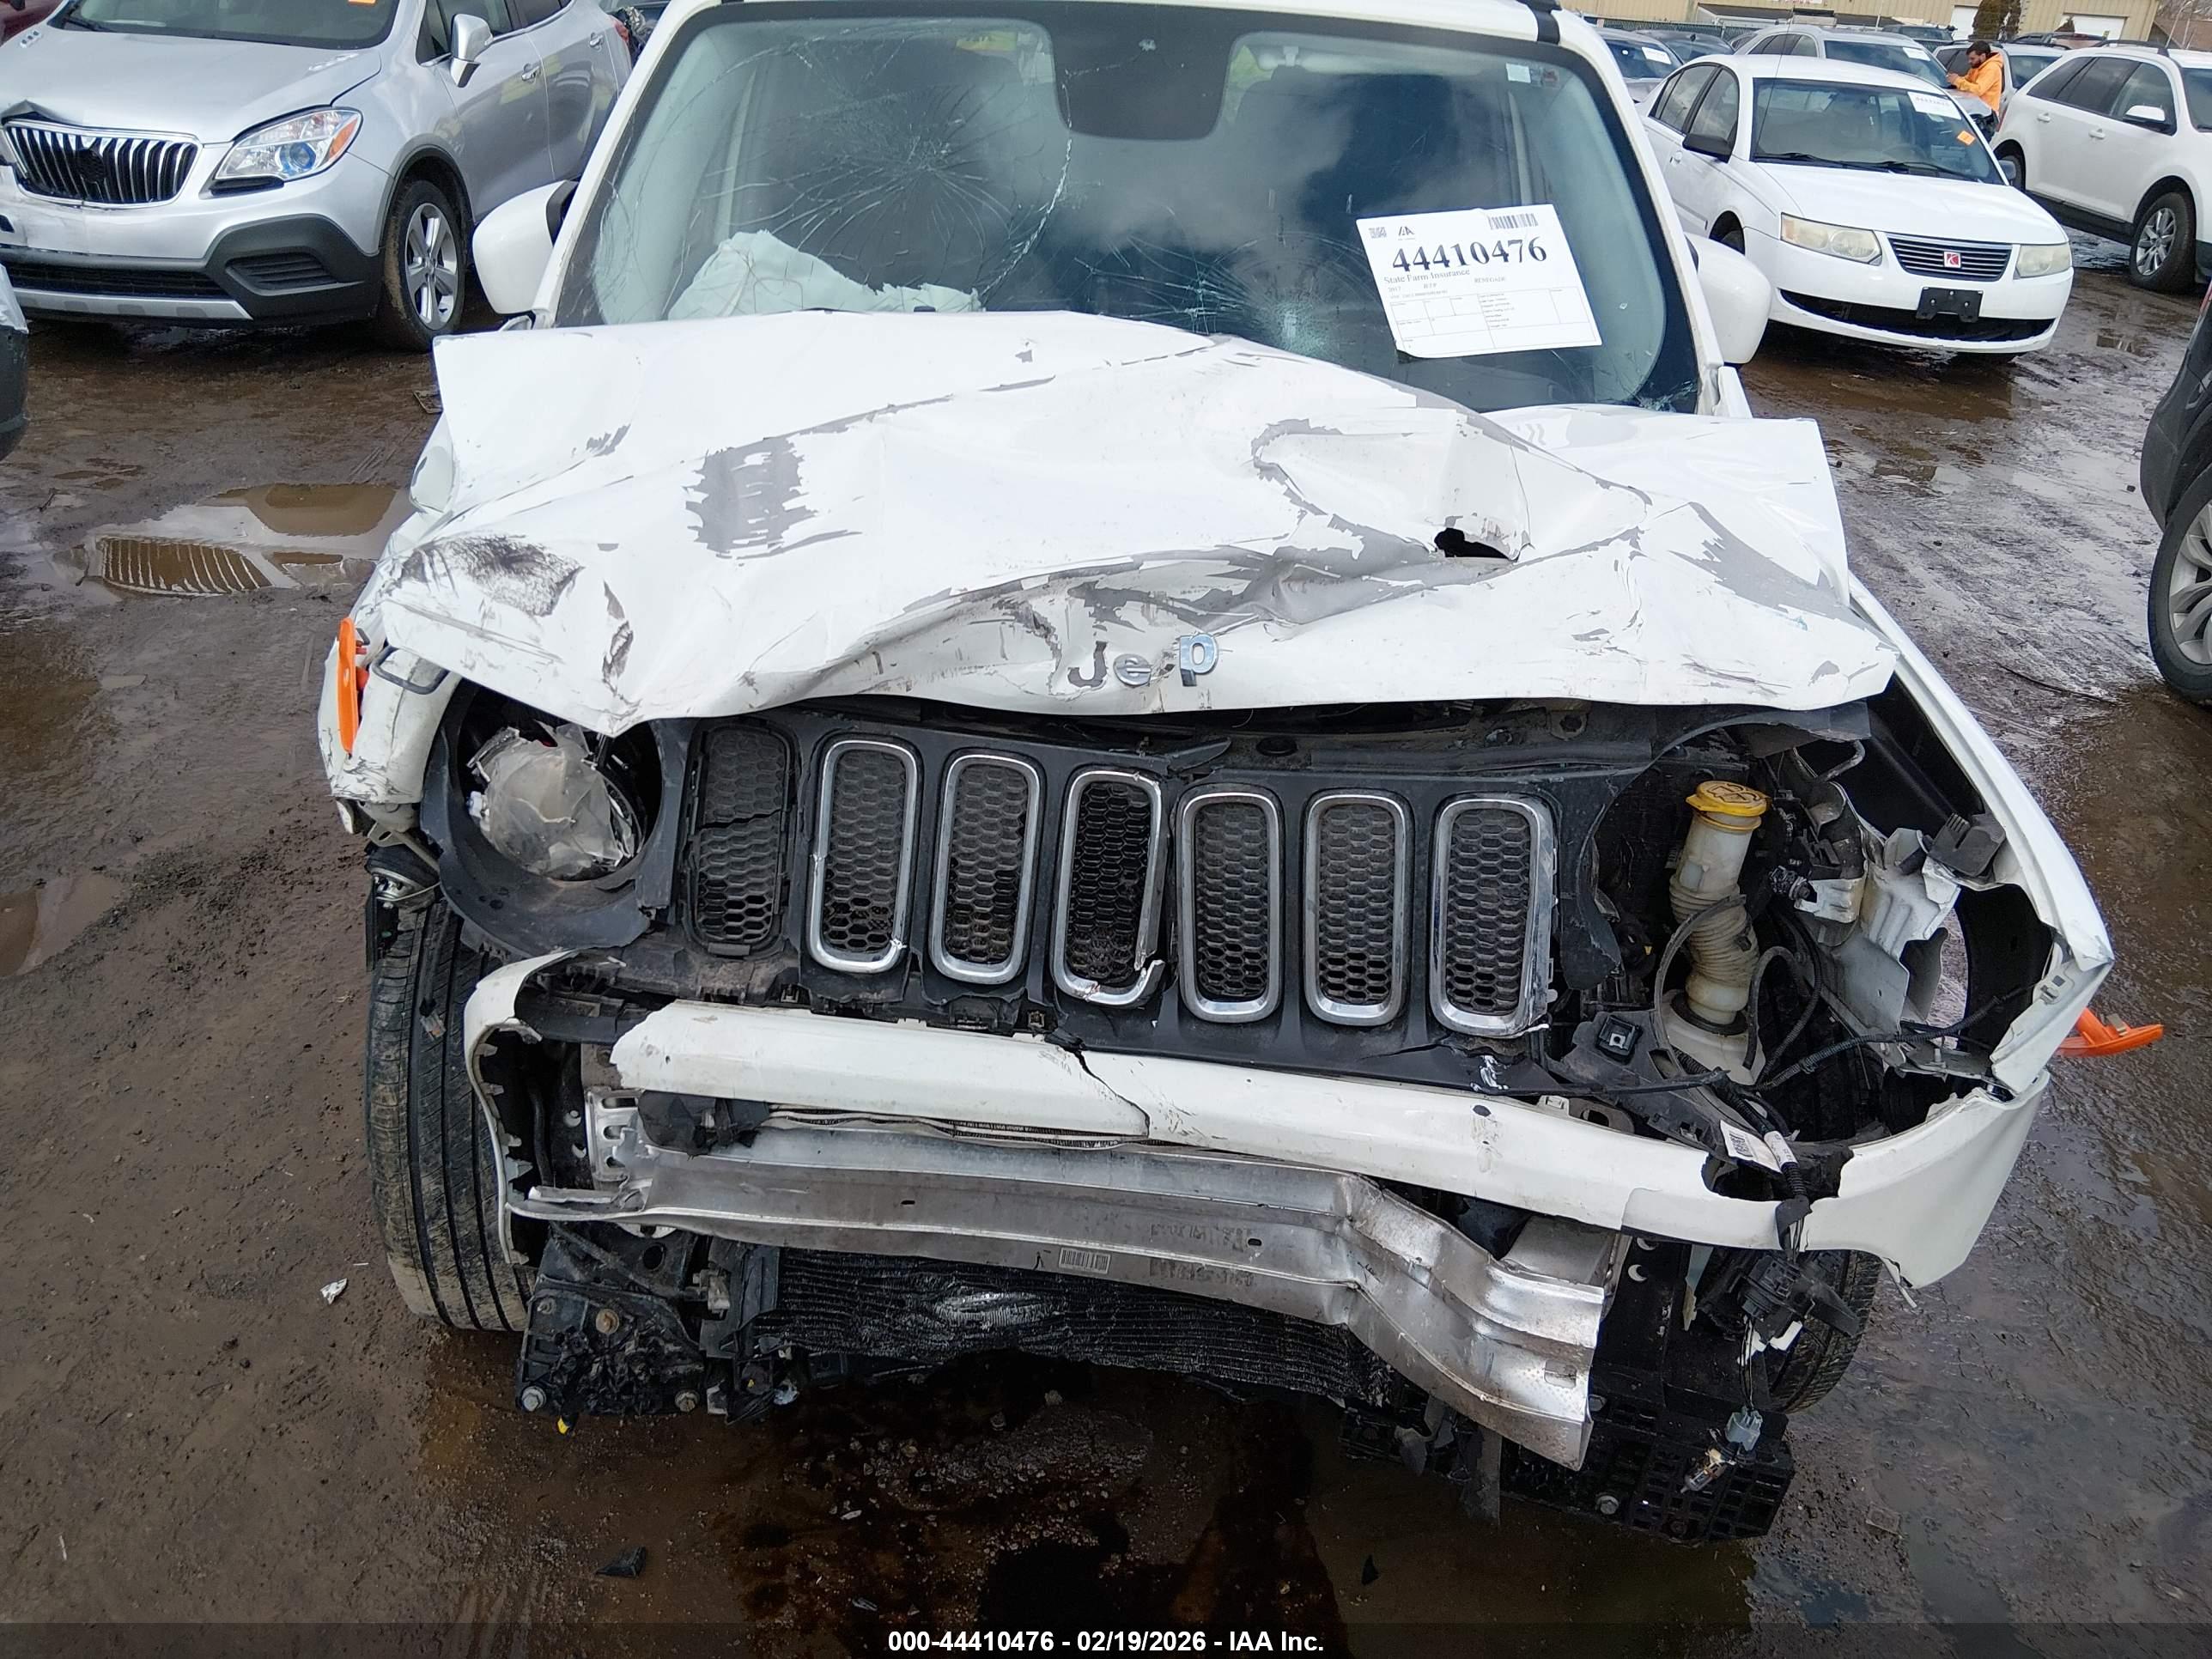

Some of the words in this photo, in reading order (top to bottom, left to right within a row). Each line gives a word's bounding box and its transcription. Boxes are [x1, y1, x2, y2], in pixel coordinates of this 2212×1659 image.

[1392, 236, 1547, 271] 44410476
[1383, 275, 1406, 284] State
[1407, 273, 1429, 282] Farm
[1430, 268, 1471, 280] Insurance
[1067, 632, 1219, 687] Jep
